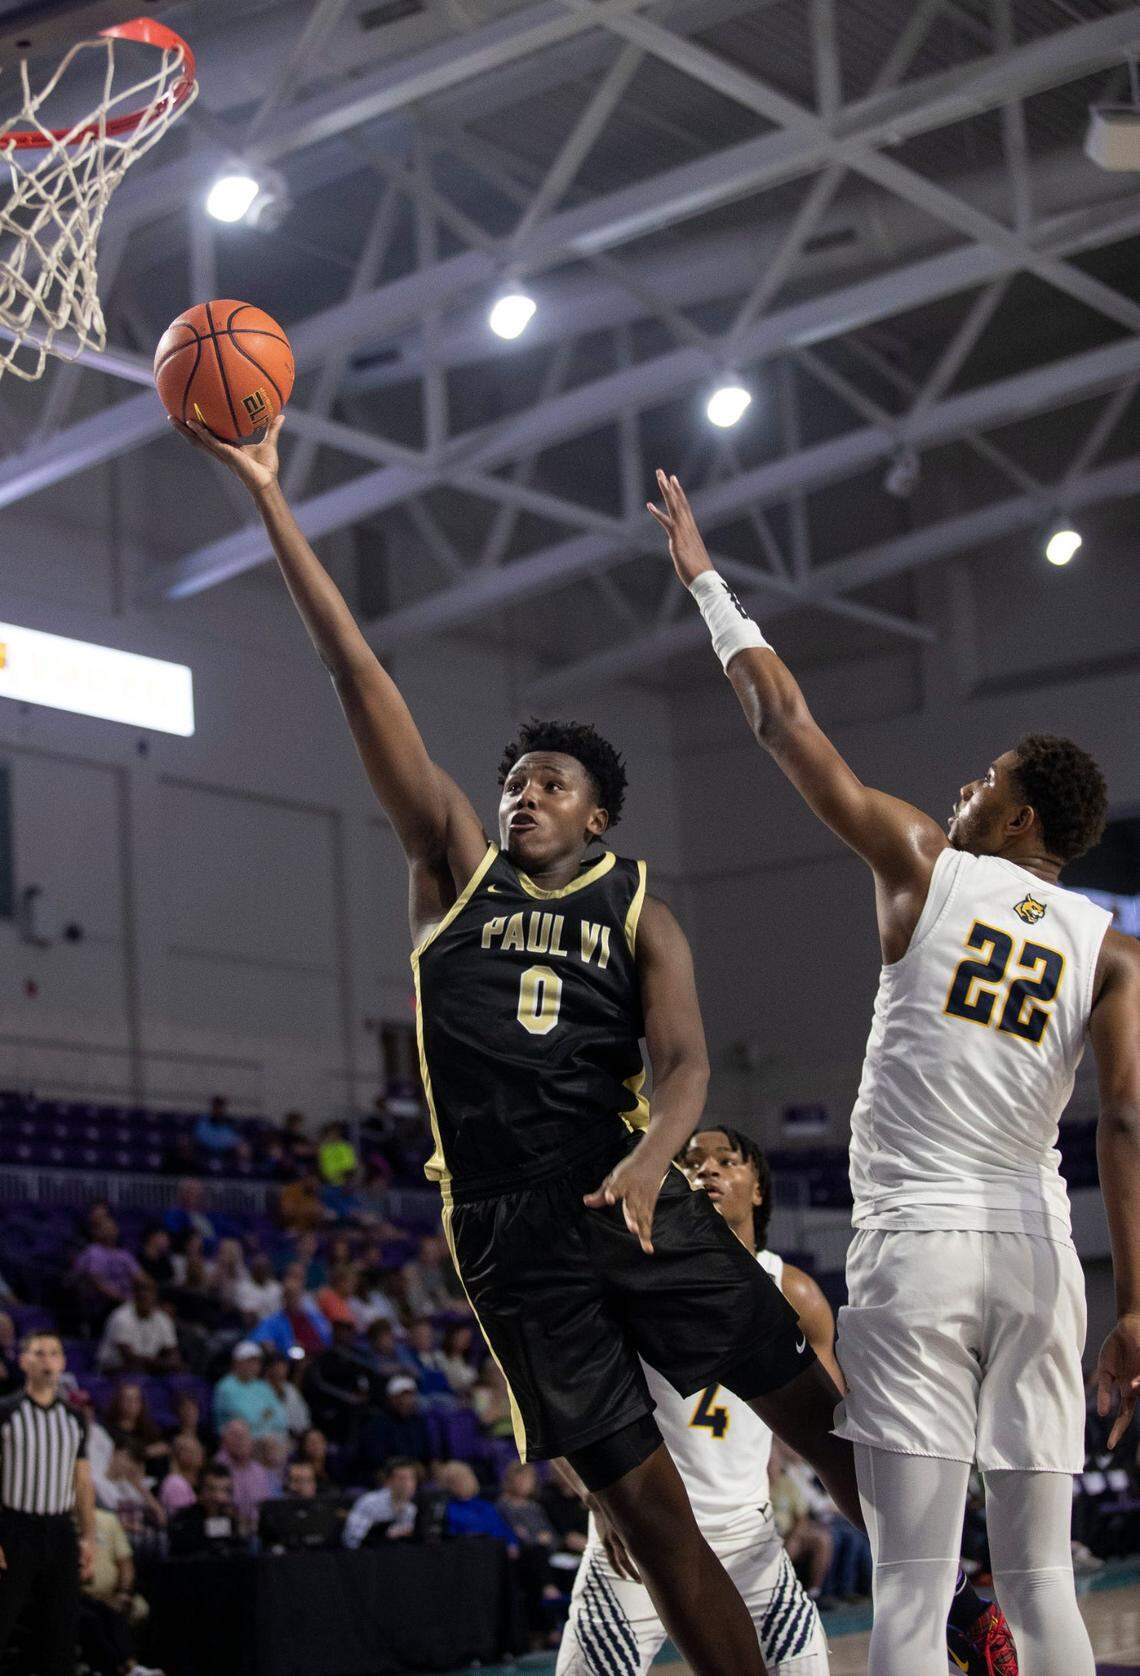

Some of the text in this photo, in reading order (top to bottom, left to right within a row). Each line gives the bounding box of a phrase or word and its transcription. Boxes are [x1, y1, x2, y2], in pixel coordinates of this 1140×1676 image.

[481, 911, 611, 969] PAUL VI
[517, 965, 563, 1035] 0
[943, 919, 1066, 1047] 22
[688, 1382, 731, 1441] 4
